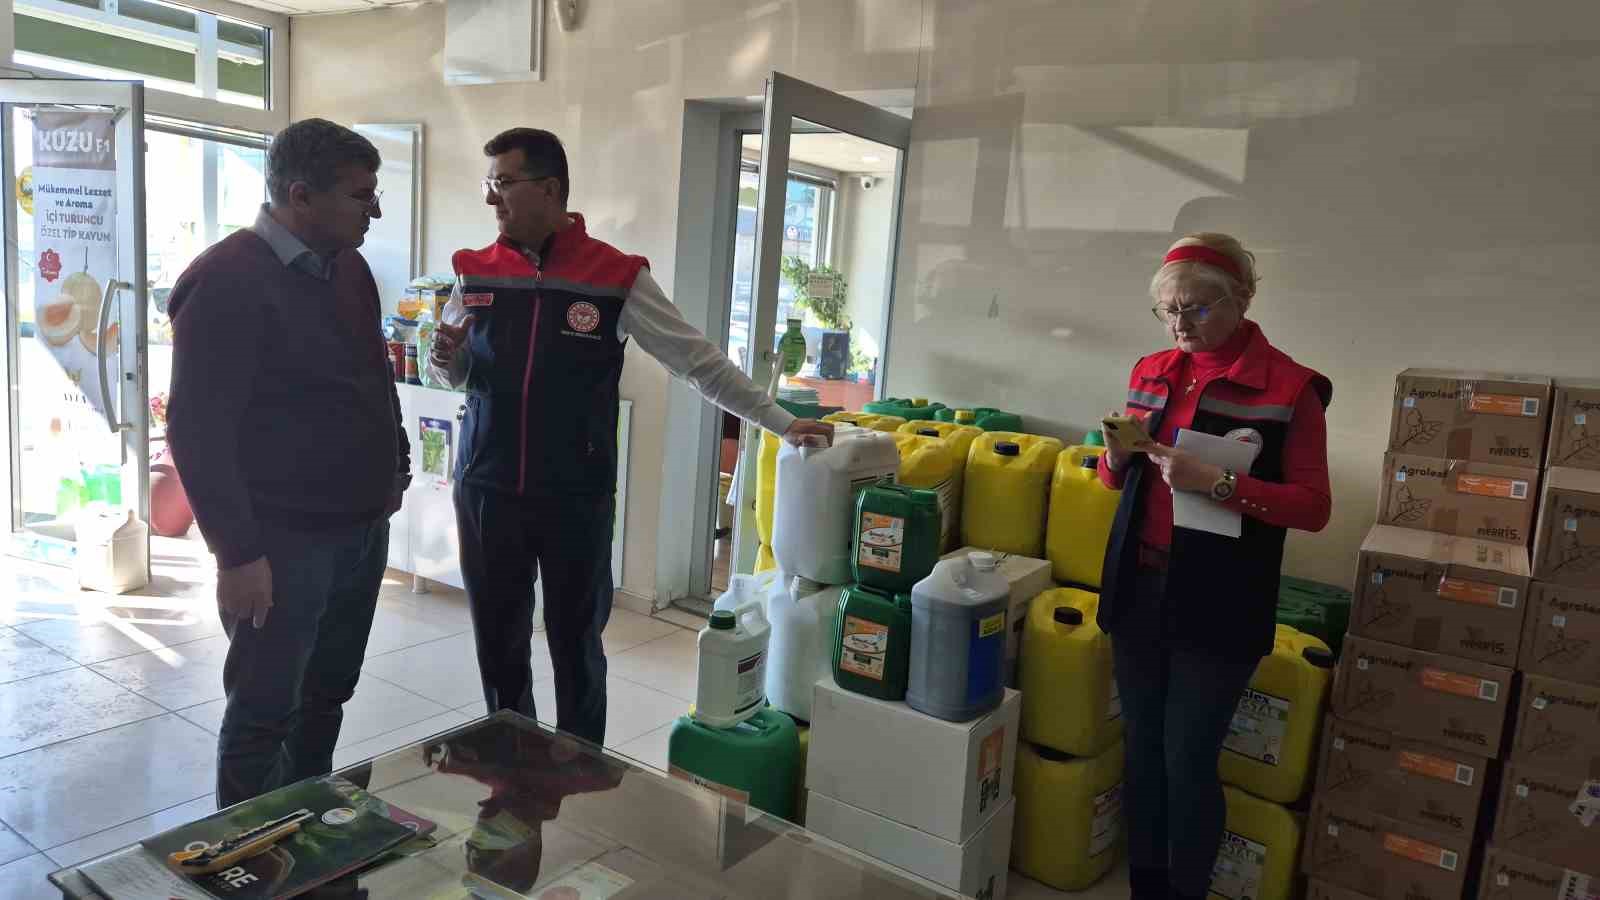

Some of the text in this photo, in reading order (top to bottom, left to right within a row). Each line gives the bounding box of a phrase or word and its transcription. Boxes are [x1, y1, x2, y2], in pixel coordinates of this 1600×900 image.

[38, 184, 82, 195] Mükemmel
[65, 198, 93, 208] Aroma
[59, 212, 103, 225] TURUNCU
[1400, 464, 1448, 478] Agroleaf
